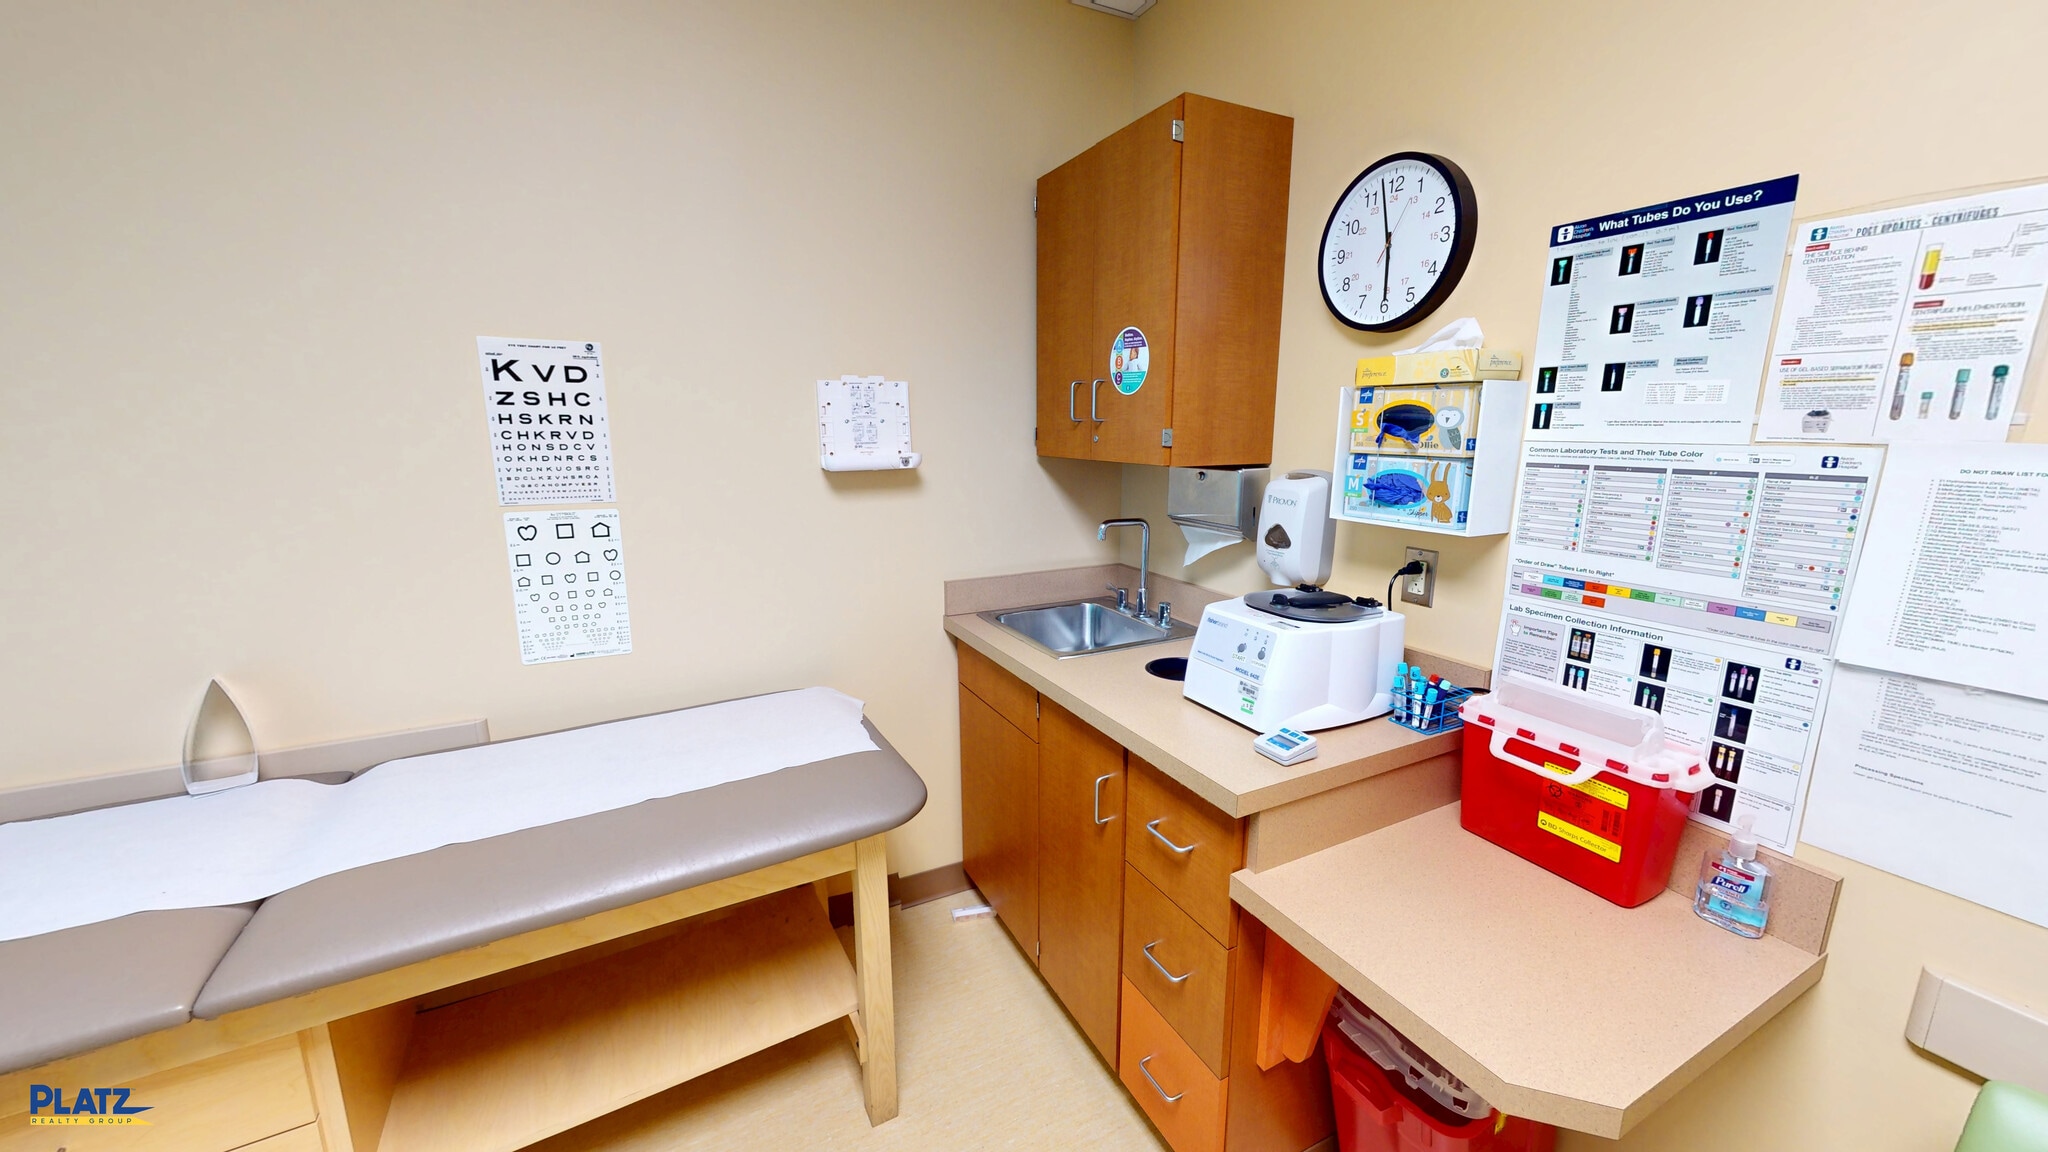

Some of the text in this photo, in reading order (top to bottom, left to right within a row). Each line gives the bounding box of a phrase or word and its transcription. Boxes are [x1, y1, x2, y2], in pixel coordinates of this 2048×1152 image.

[1389, 176, 1406, 193] 12
[1418, 177, 1424, 193] 1
[1364, 190, 1378, 208] 11
[1434, 196, 1446, 214] 2
[1599, 190, 1763, 232] What Tubes Do You Use?
[1346, 220, 1360, 236] 10
[1856, 226, 1879, 237] POCT
[1881, 219, 1922, 233] UPDATES
[1932, 207, 2000, 227] CENTRIFUGES
[1440, 226, 1450, 242] 3
[1337, 250, 1345, 264] 9
[1803, 254, 1855, 265] CENTRIFUGATION
[1819, 249, 1843, 257] SCIENCE
[1428, 260, 1438, 276] 4
[1342, 276, 1351, 292] 8
[1358, 294, 1367, 309] 7
[1405, 286, 1415, 303] 5
[1380, 298, 1388, 314] 6
[1356, 412, 1364, 426] S
[1679, 450, 1704, 458] Color
[1348, 478, 1359, 491] M
[1559, 564, 1575, 572] Tubes
[1509, 604, 1664, 641] Lab Specimen Collection Information
[1524, 625, 1558, 637] Important Tips
[1235, 667, 1249, 676] MODEL
[1548, 822, 1607, 852] BD Sharps Collector
[1715, 877, 1746, 892] Purell
